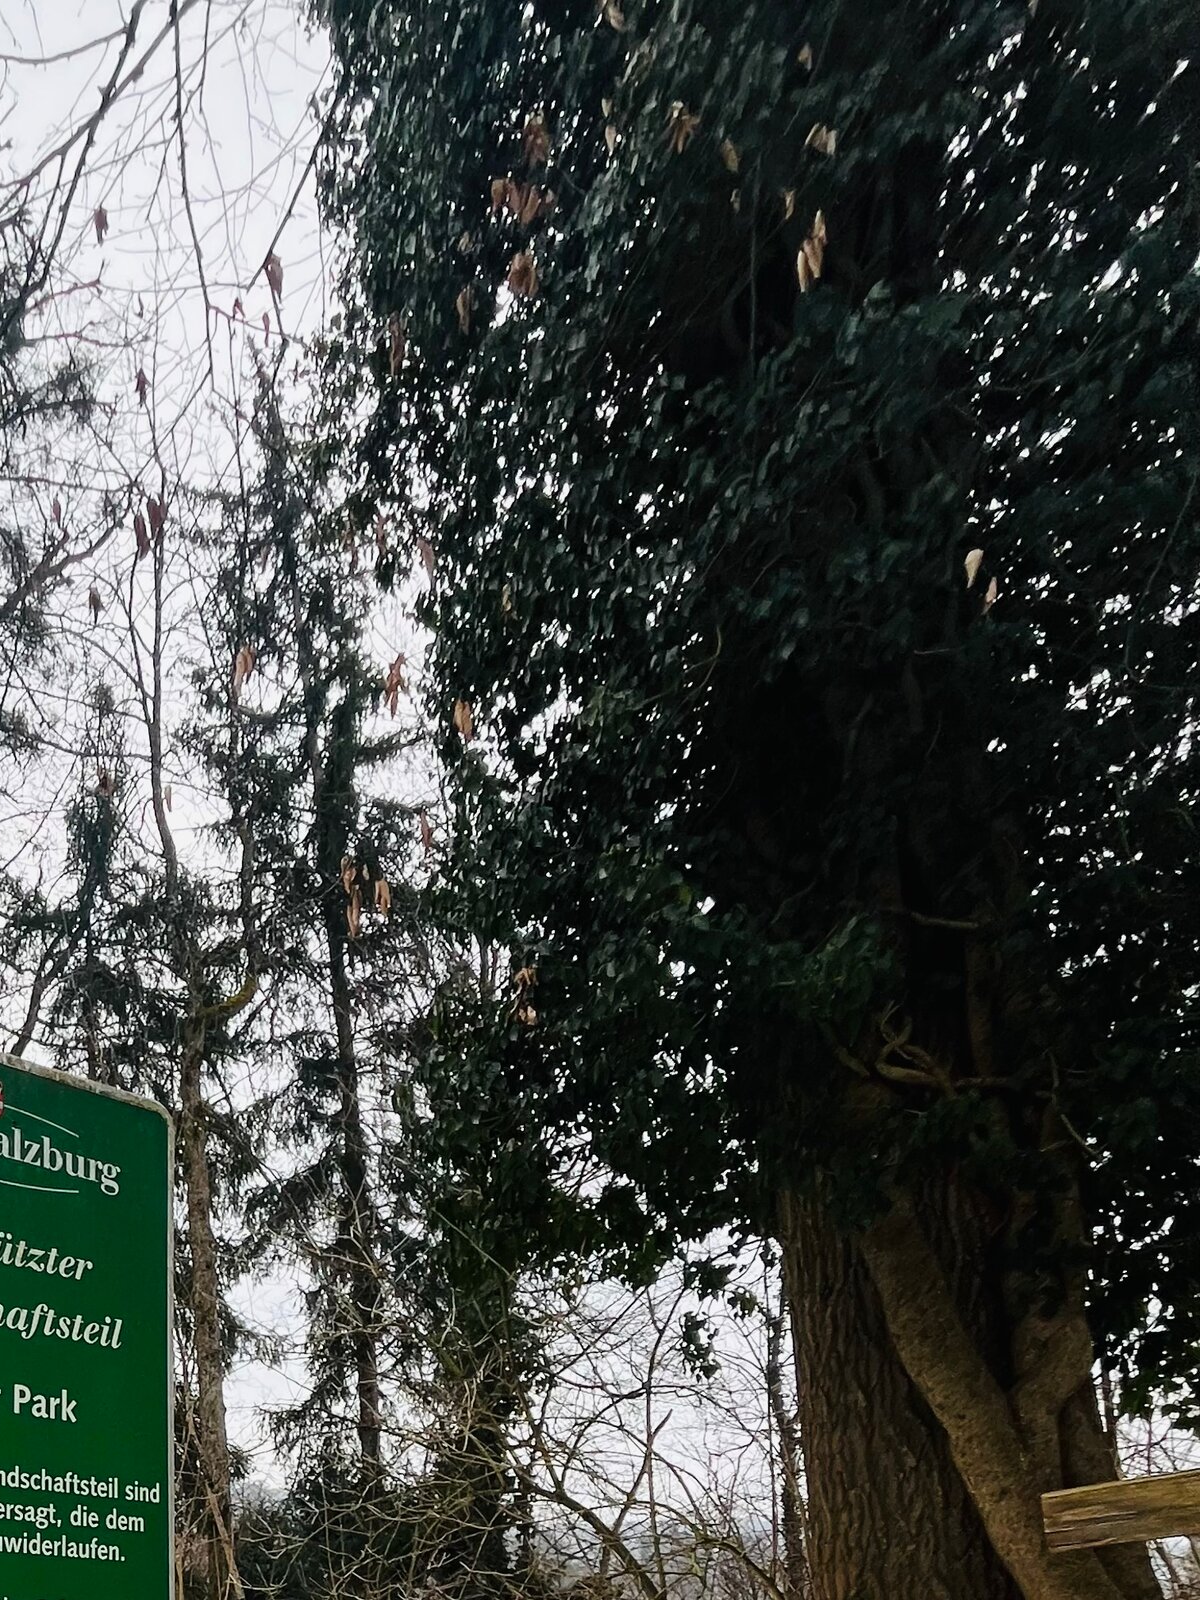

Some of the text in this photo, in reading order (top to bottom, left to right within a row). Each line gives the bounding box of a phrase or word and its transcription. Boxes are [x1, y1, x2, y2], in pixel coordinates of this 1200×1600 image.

[13, 1383, 78, 1423] Park
[125, 1481, 160, 1503] sind
[70, 1503, 99, 1528] die
[105, 1508, 145, 1532] dem
